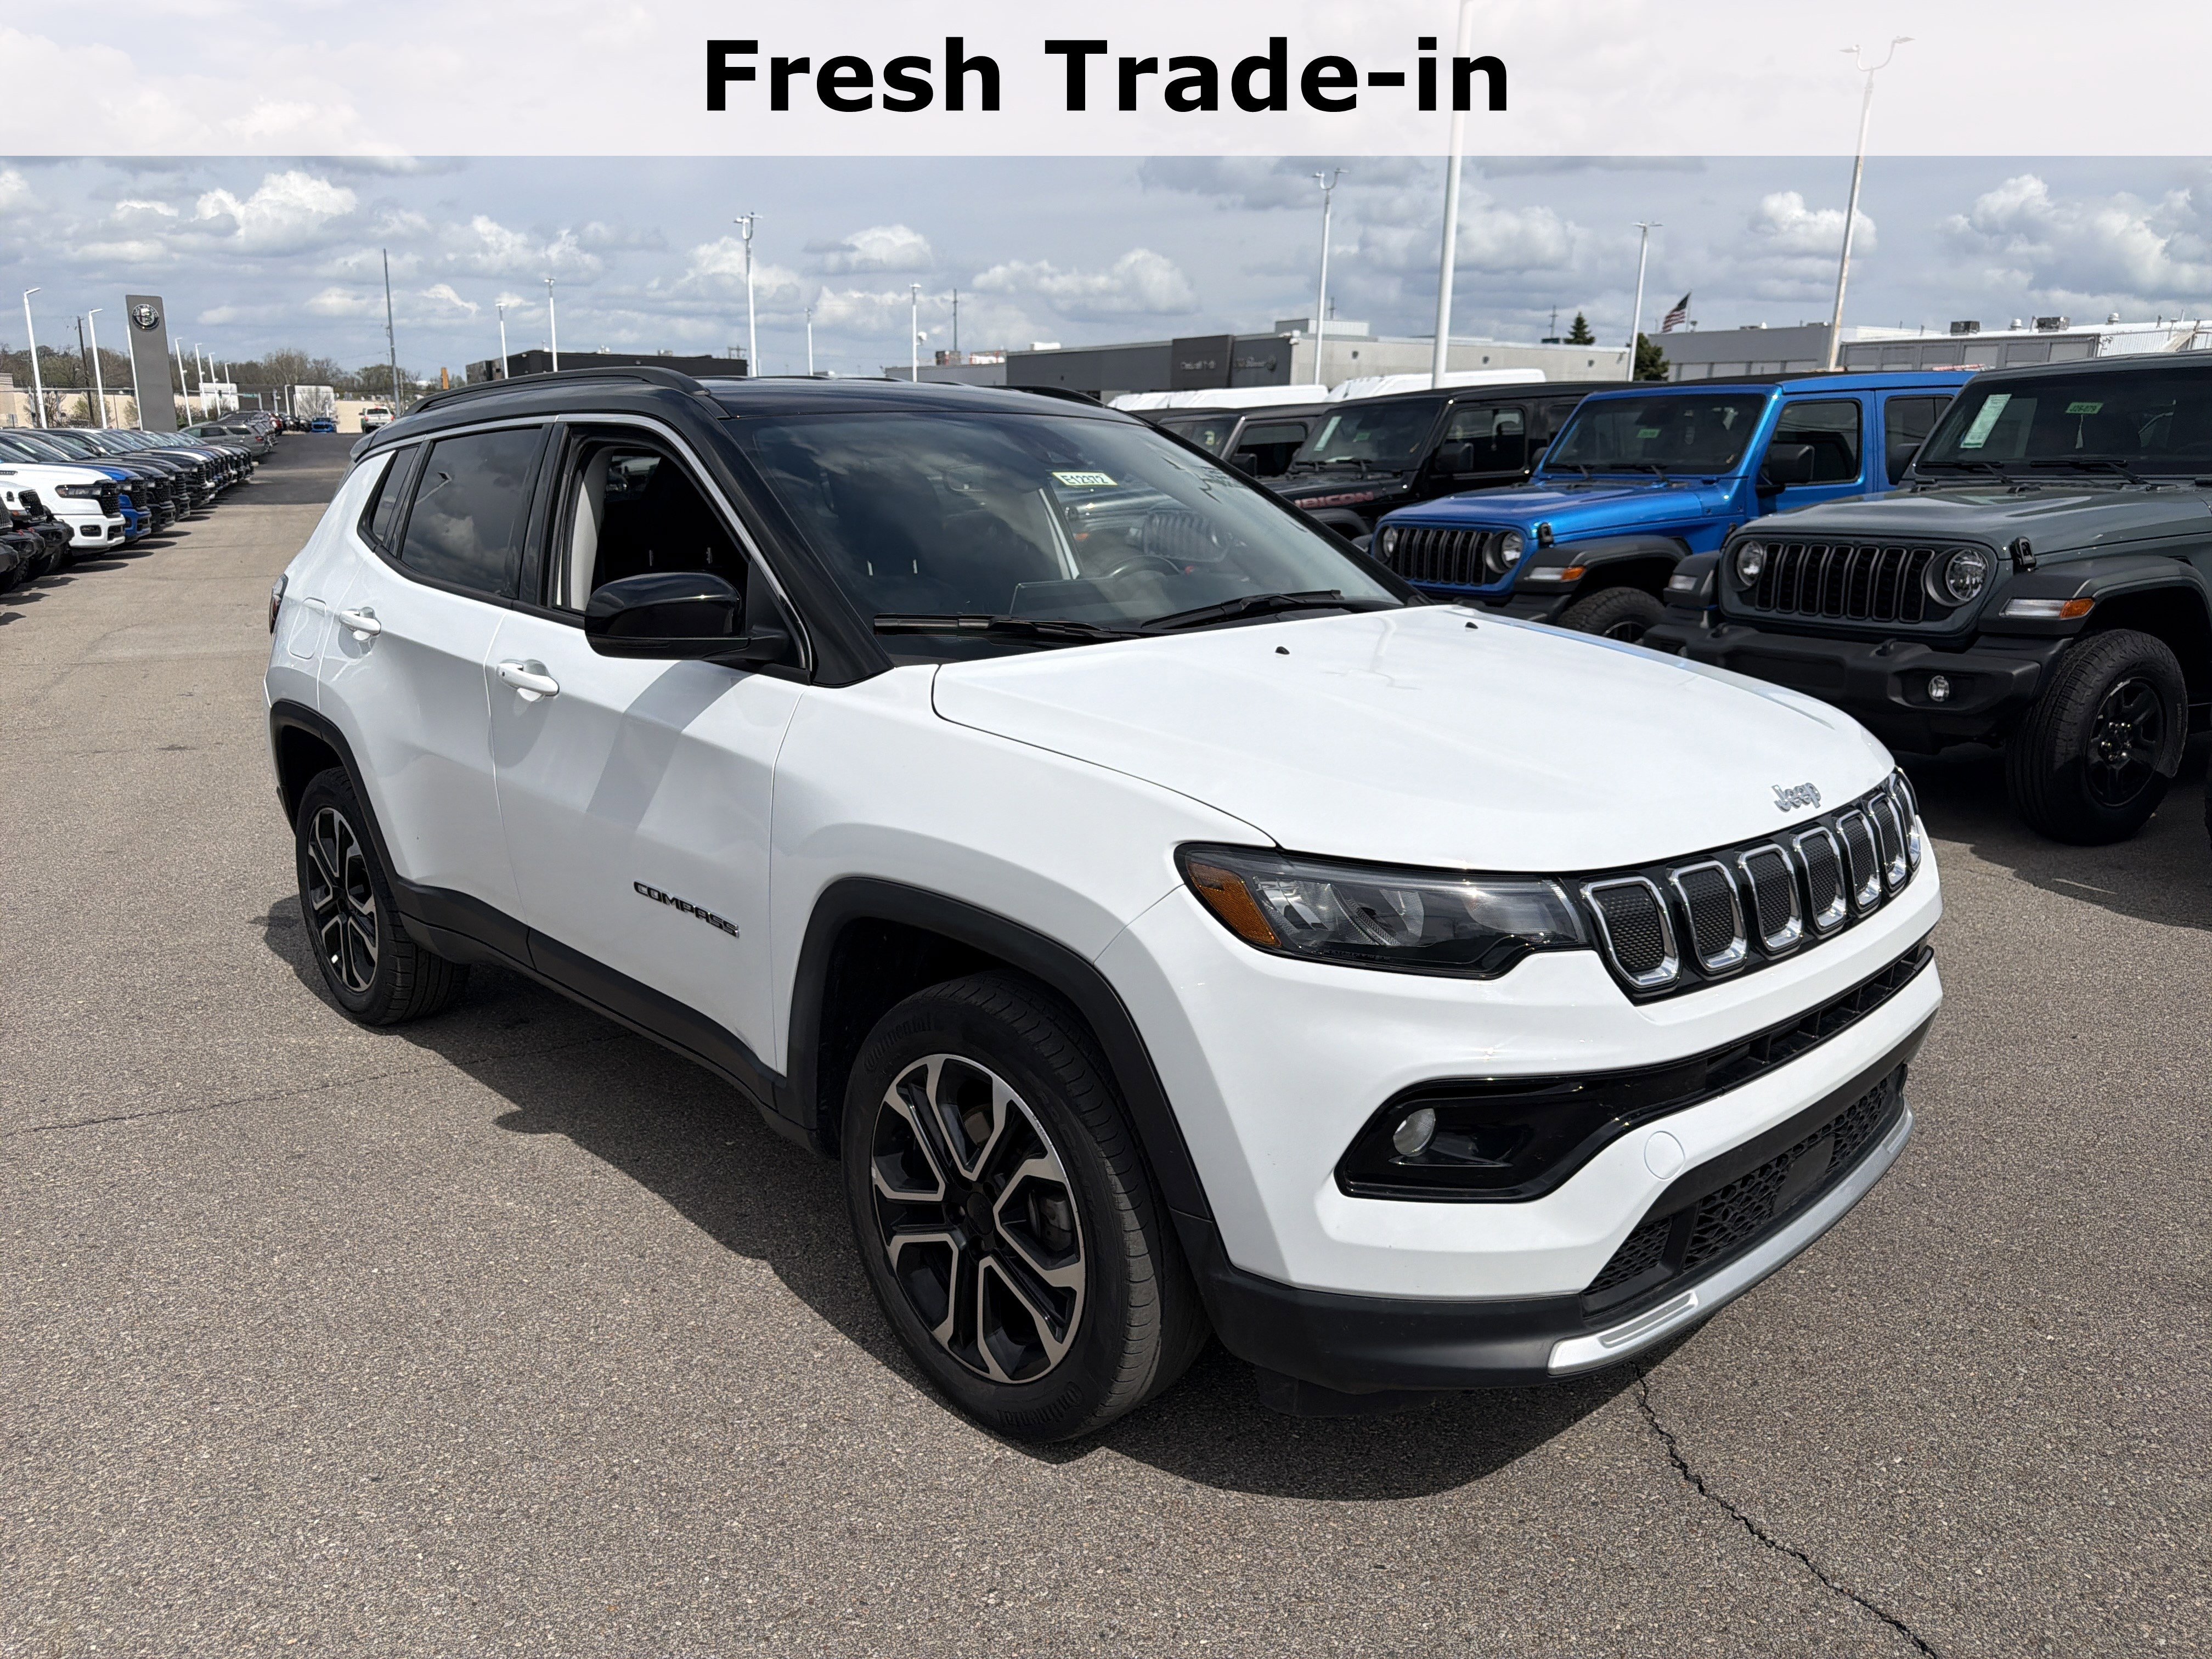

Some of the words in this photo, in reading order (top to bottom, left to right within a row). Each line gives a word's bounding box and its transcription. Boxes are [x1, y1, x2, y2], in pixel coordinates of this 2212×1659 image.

[1060, 475, 1109, 484] E12372
[1771, 782, 1821, 812] Jeep
[633, 880, 740, 939] COMPASS
